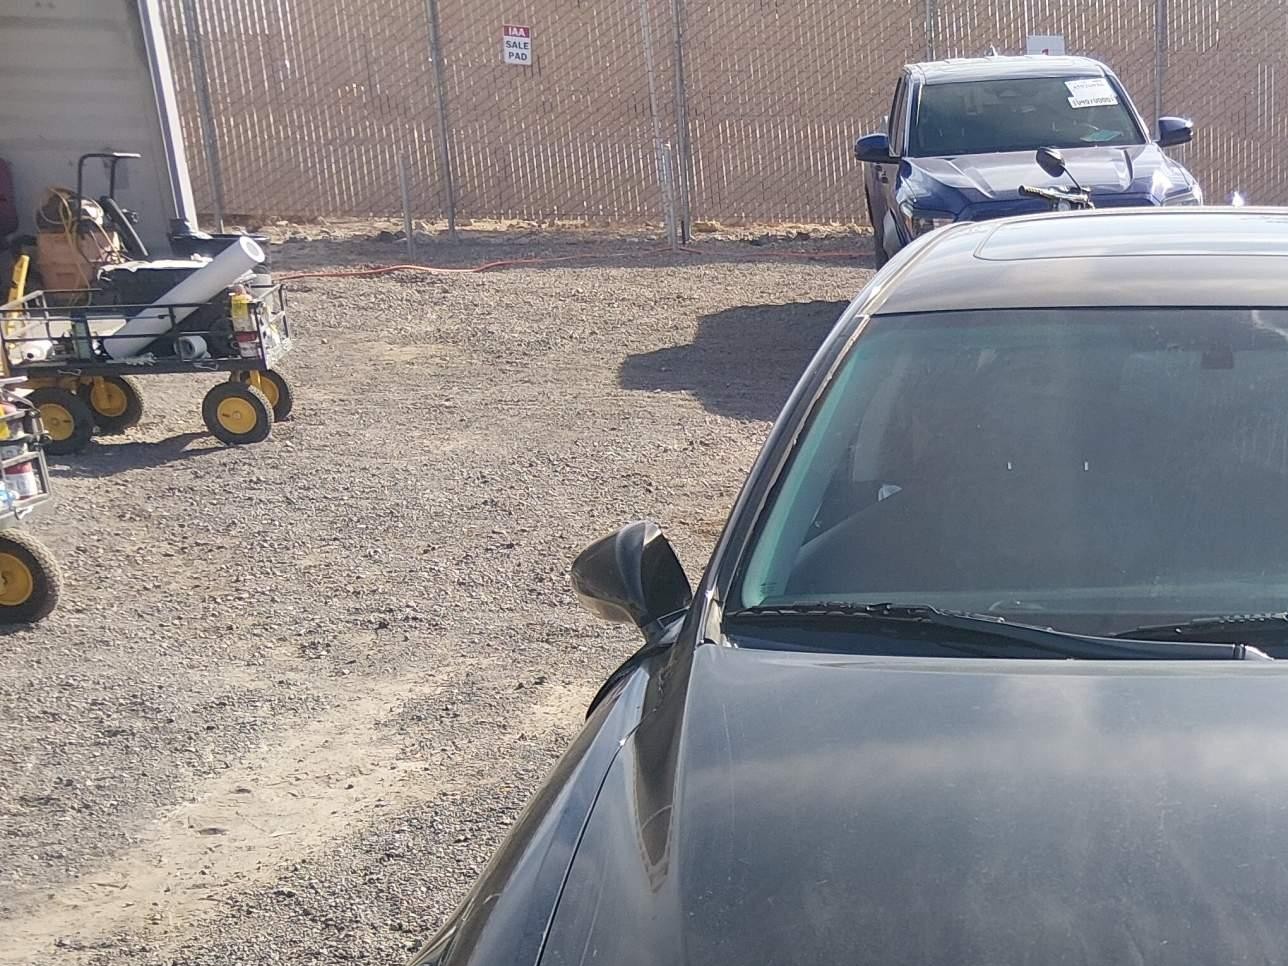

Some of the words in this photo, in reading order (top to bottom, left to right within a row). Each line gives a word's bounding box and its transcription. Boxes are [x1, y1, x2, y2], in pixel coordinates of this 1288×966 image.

[509, 26, 526, 37] IAA
[505, 40, 529, 50] SALE
[508, 51, 528, 61] PAD
